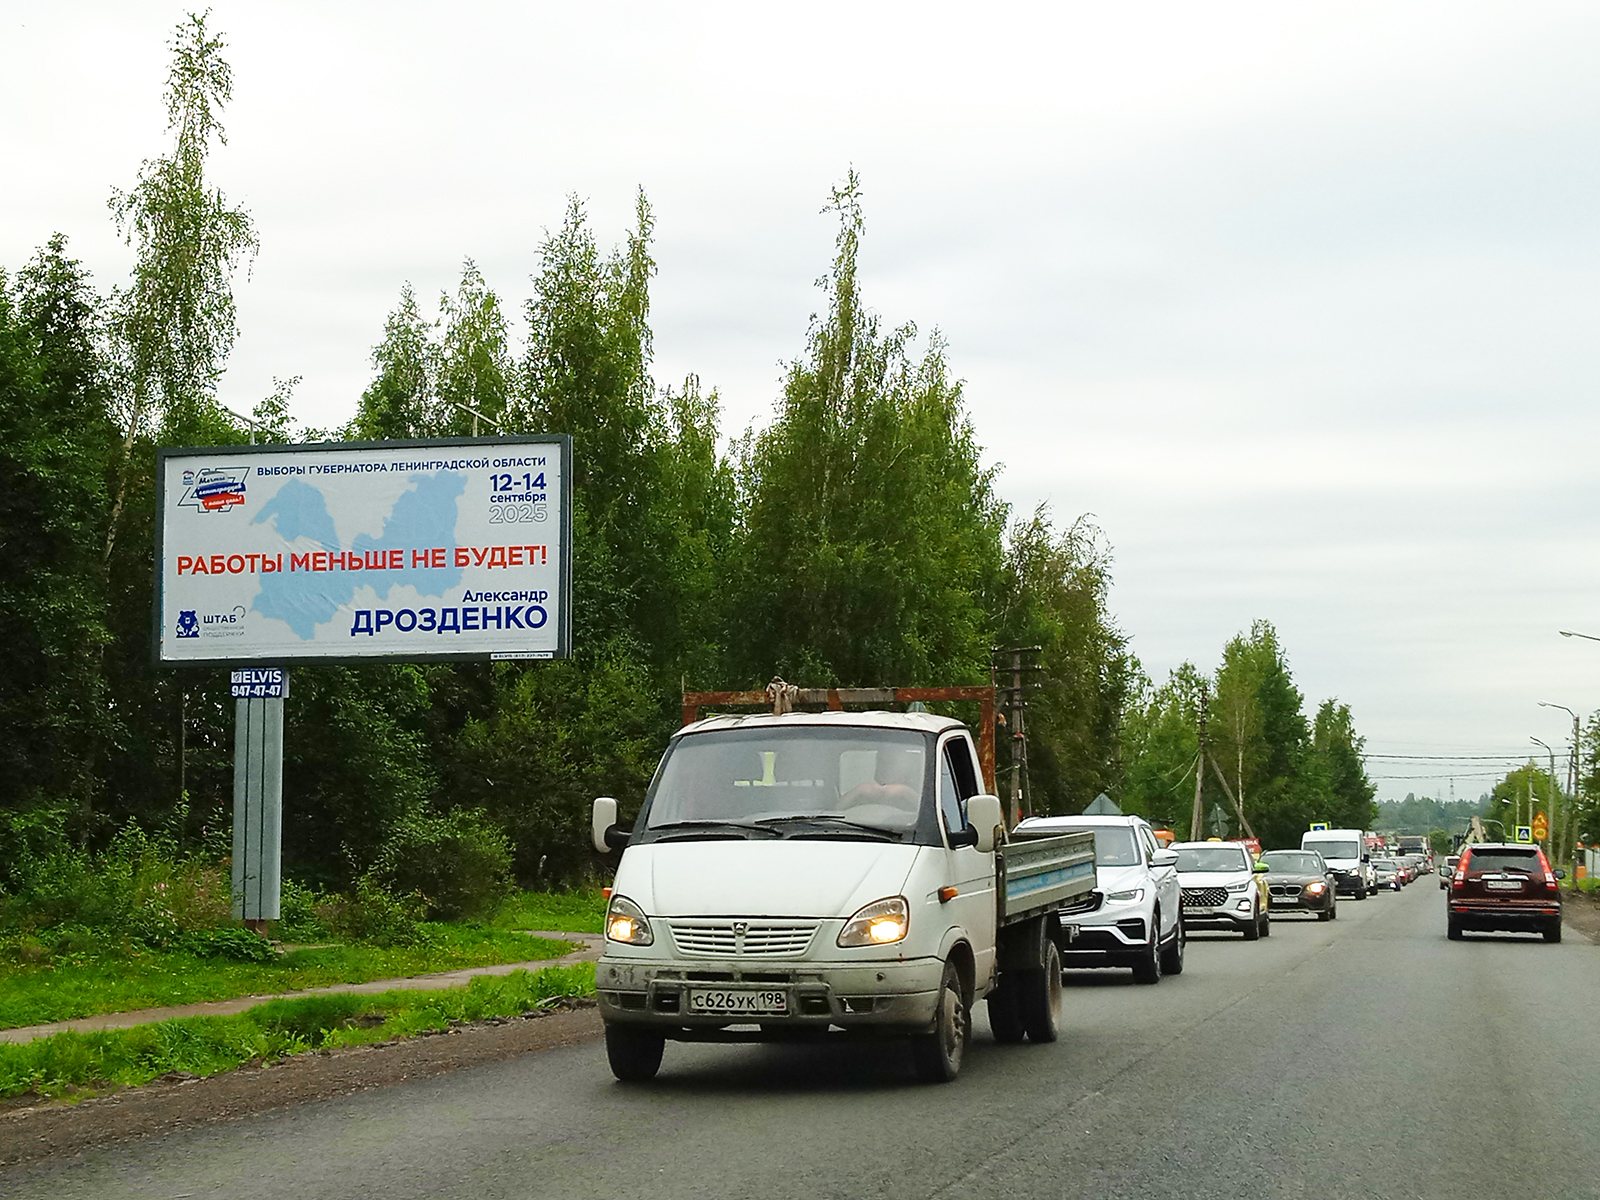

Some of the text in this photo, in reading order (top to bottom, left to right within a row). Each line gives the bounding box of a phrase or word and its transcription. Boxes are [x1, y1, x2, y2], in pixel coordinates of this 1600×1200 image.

[257, 457, 546, 476] ВЫБОРЫ ГУБЕРНАТОРА ЛЕНИНГРАДСКОЙ ОБЛАСТИ
[489, 472, 547, 492] 12-14
[490, 491, 547, 504] сентября
[489, 503, 548, 524] 2025
[177, 545, 548, 575] РАБОТЫ МЕНЬШЕ НЕ БУДЕТ!
[462, 590, 548, 603] Александр
[203, 614, 237, 624] ШТАБ
[350, 604, 548, 637] ДРОЗДЕНКО
[242, 671, 282, 683] ELVIS
[231, 685, 281, 697] 947-47-47
[759, 992, 782, 1005] 198
